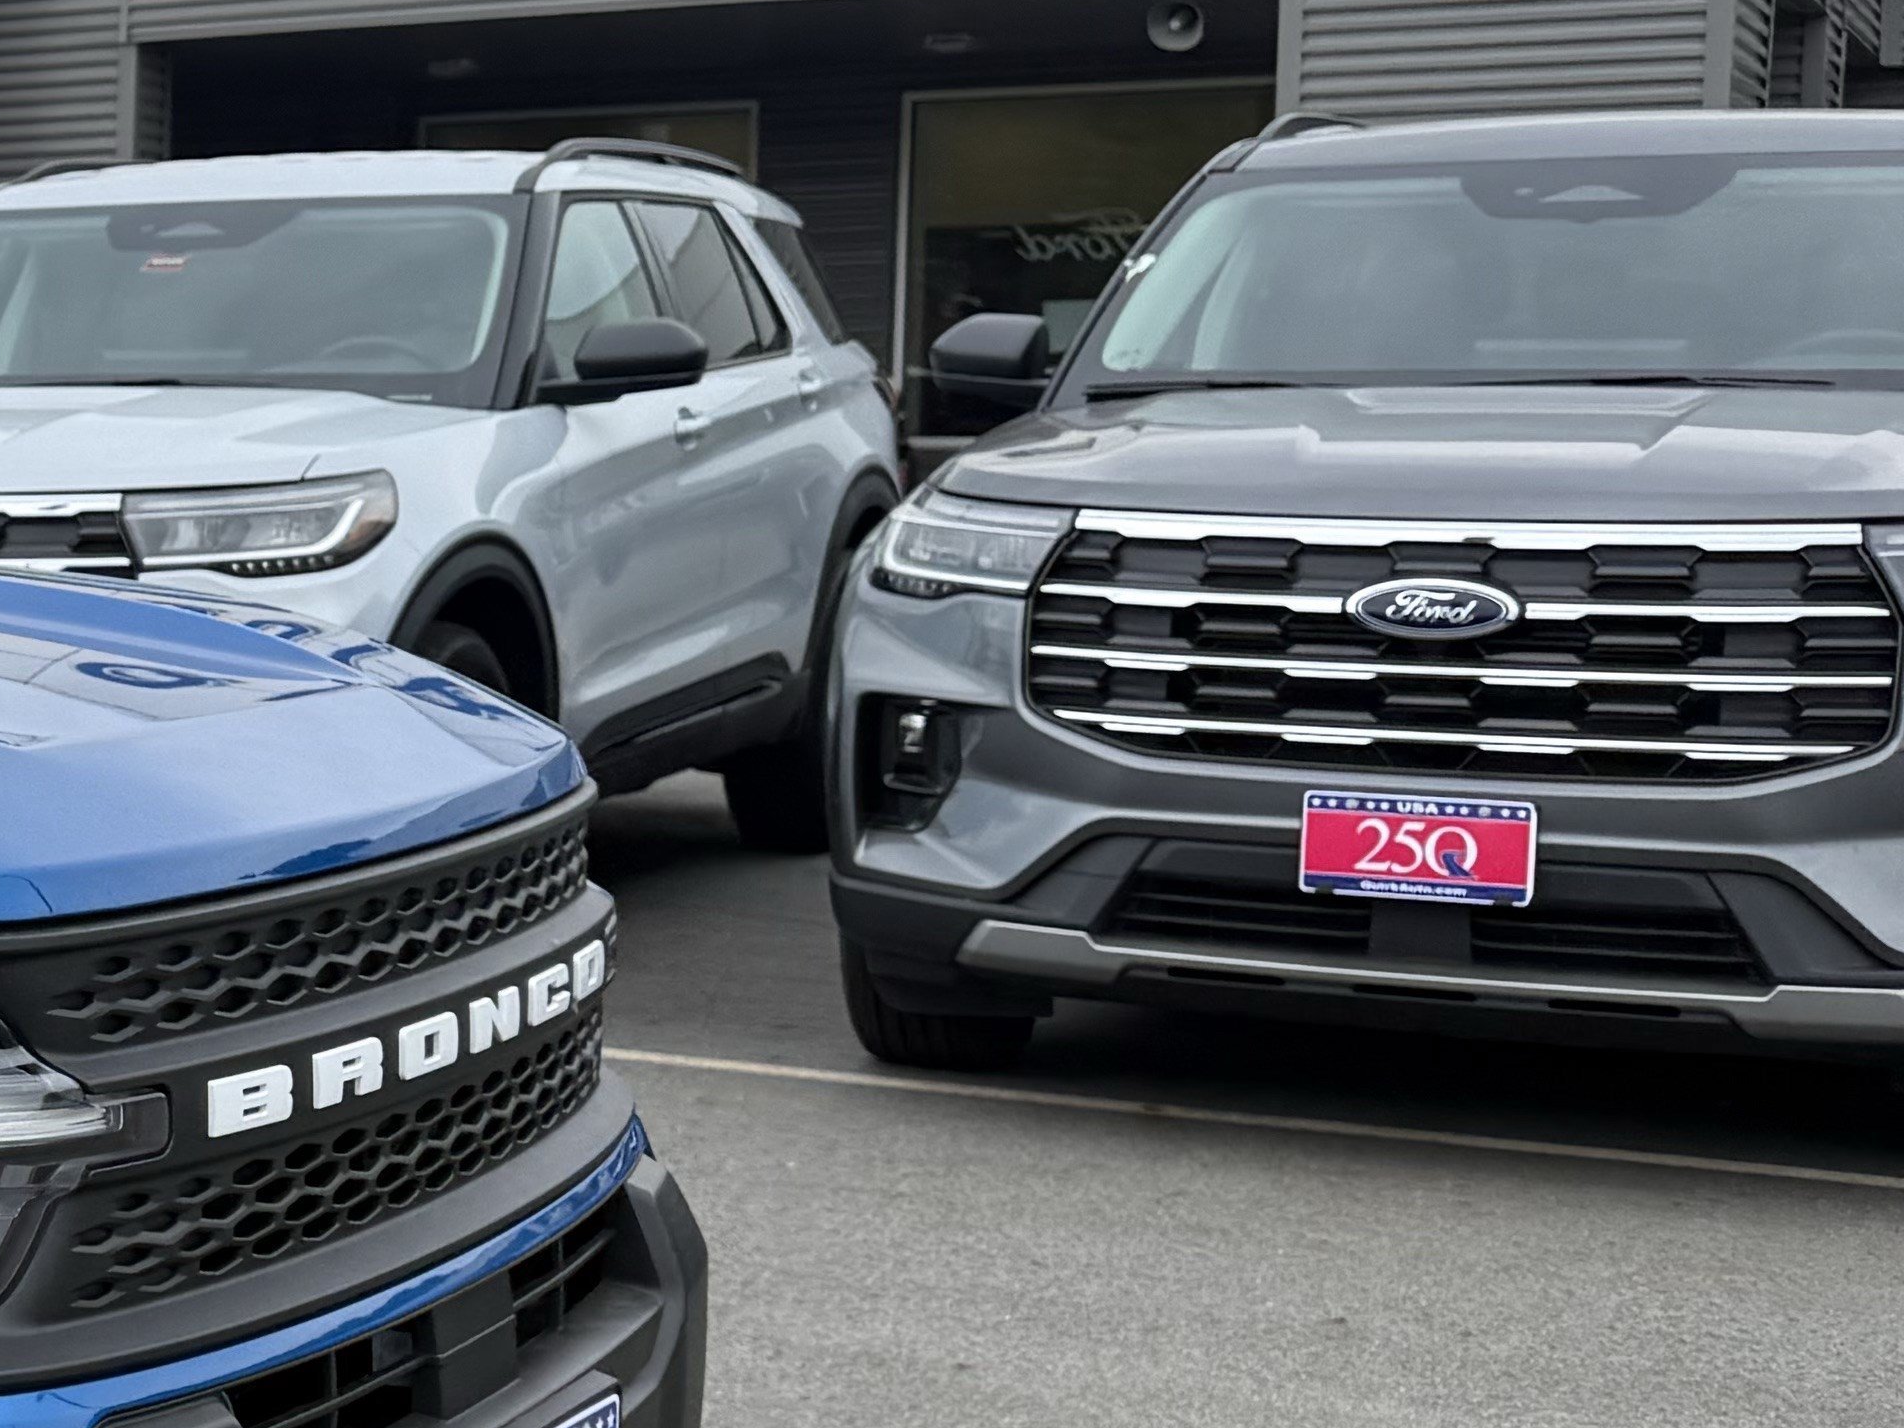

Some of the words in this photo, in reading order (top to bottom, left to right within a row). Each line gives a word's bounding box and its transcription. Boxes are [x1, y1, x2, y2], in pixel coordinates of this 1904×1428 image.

[1385, 588, 1478, 624] Ford
[1396, 801, 1439, 815] USA
[206, 938, 606, 1139] BRONCO
